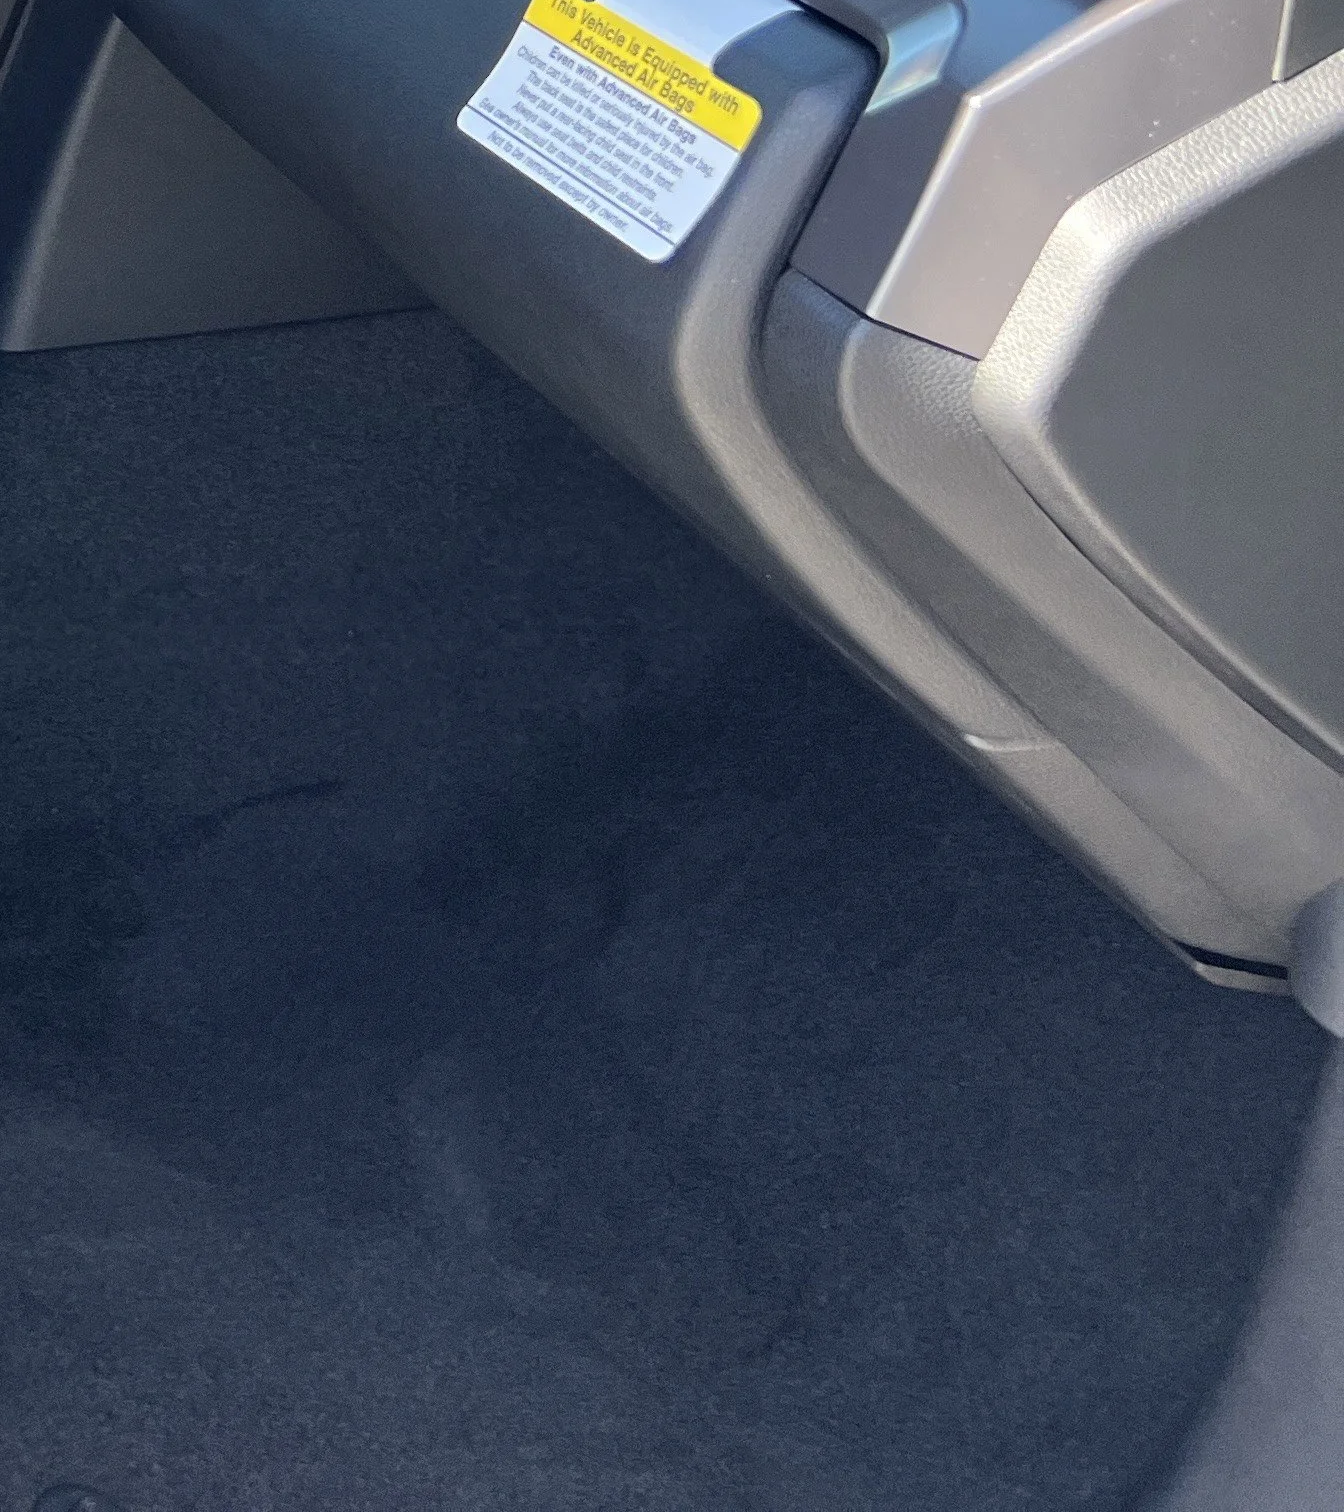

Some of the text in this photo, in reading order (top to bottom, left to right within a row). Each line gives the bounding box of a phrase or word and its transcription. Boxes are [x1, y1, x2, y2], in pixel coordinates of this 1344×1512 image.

[548, 45, 696, 144] Even with Advanced Air Bags
[571, 29, 694, 113] Advanced Air Bags
[580, 9, 625, 47] Vehicle
[625, 37, 641, 56] is
[641, 46, 708, 95] Equipped
[708, 88, 738, 115] with
